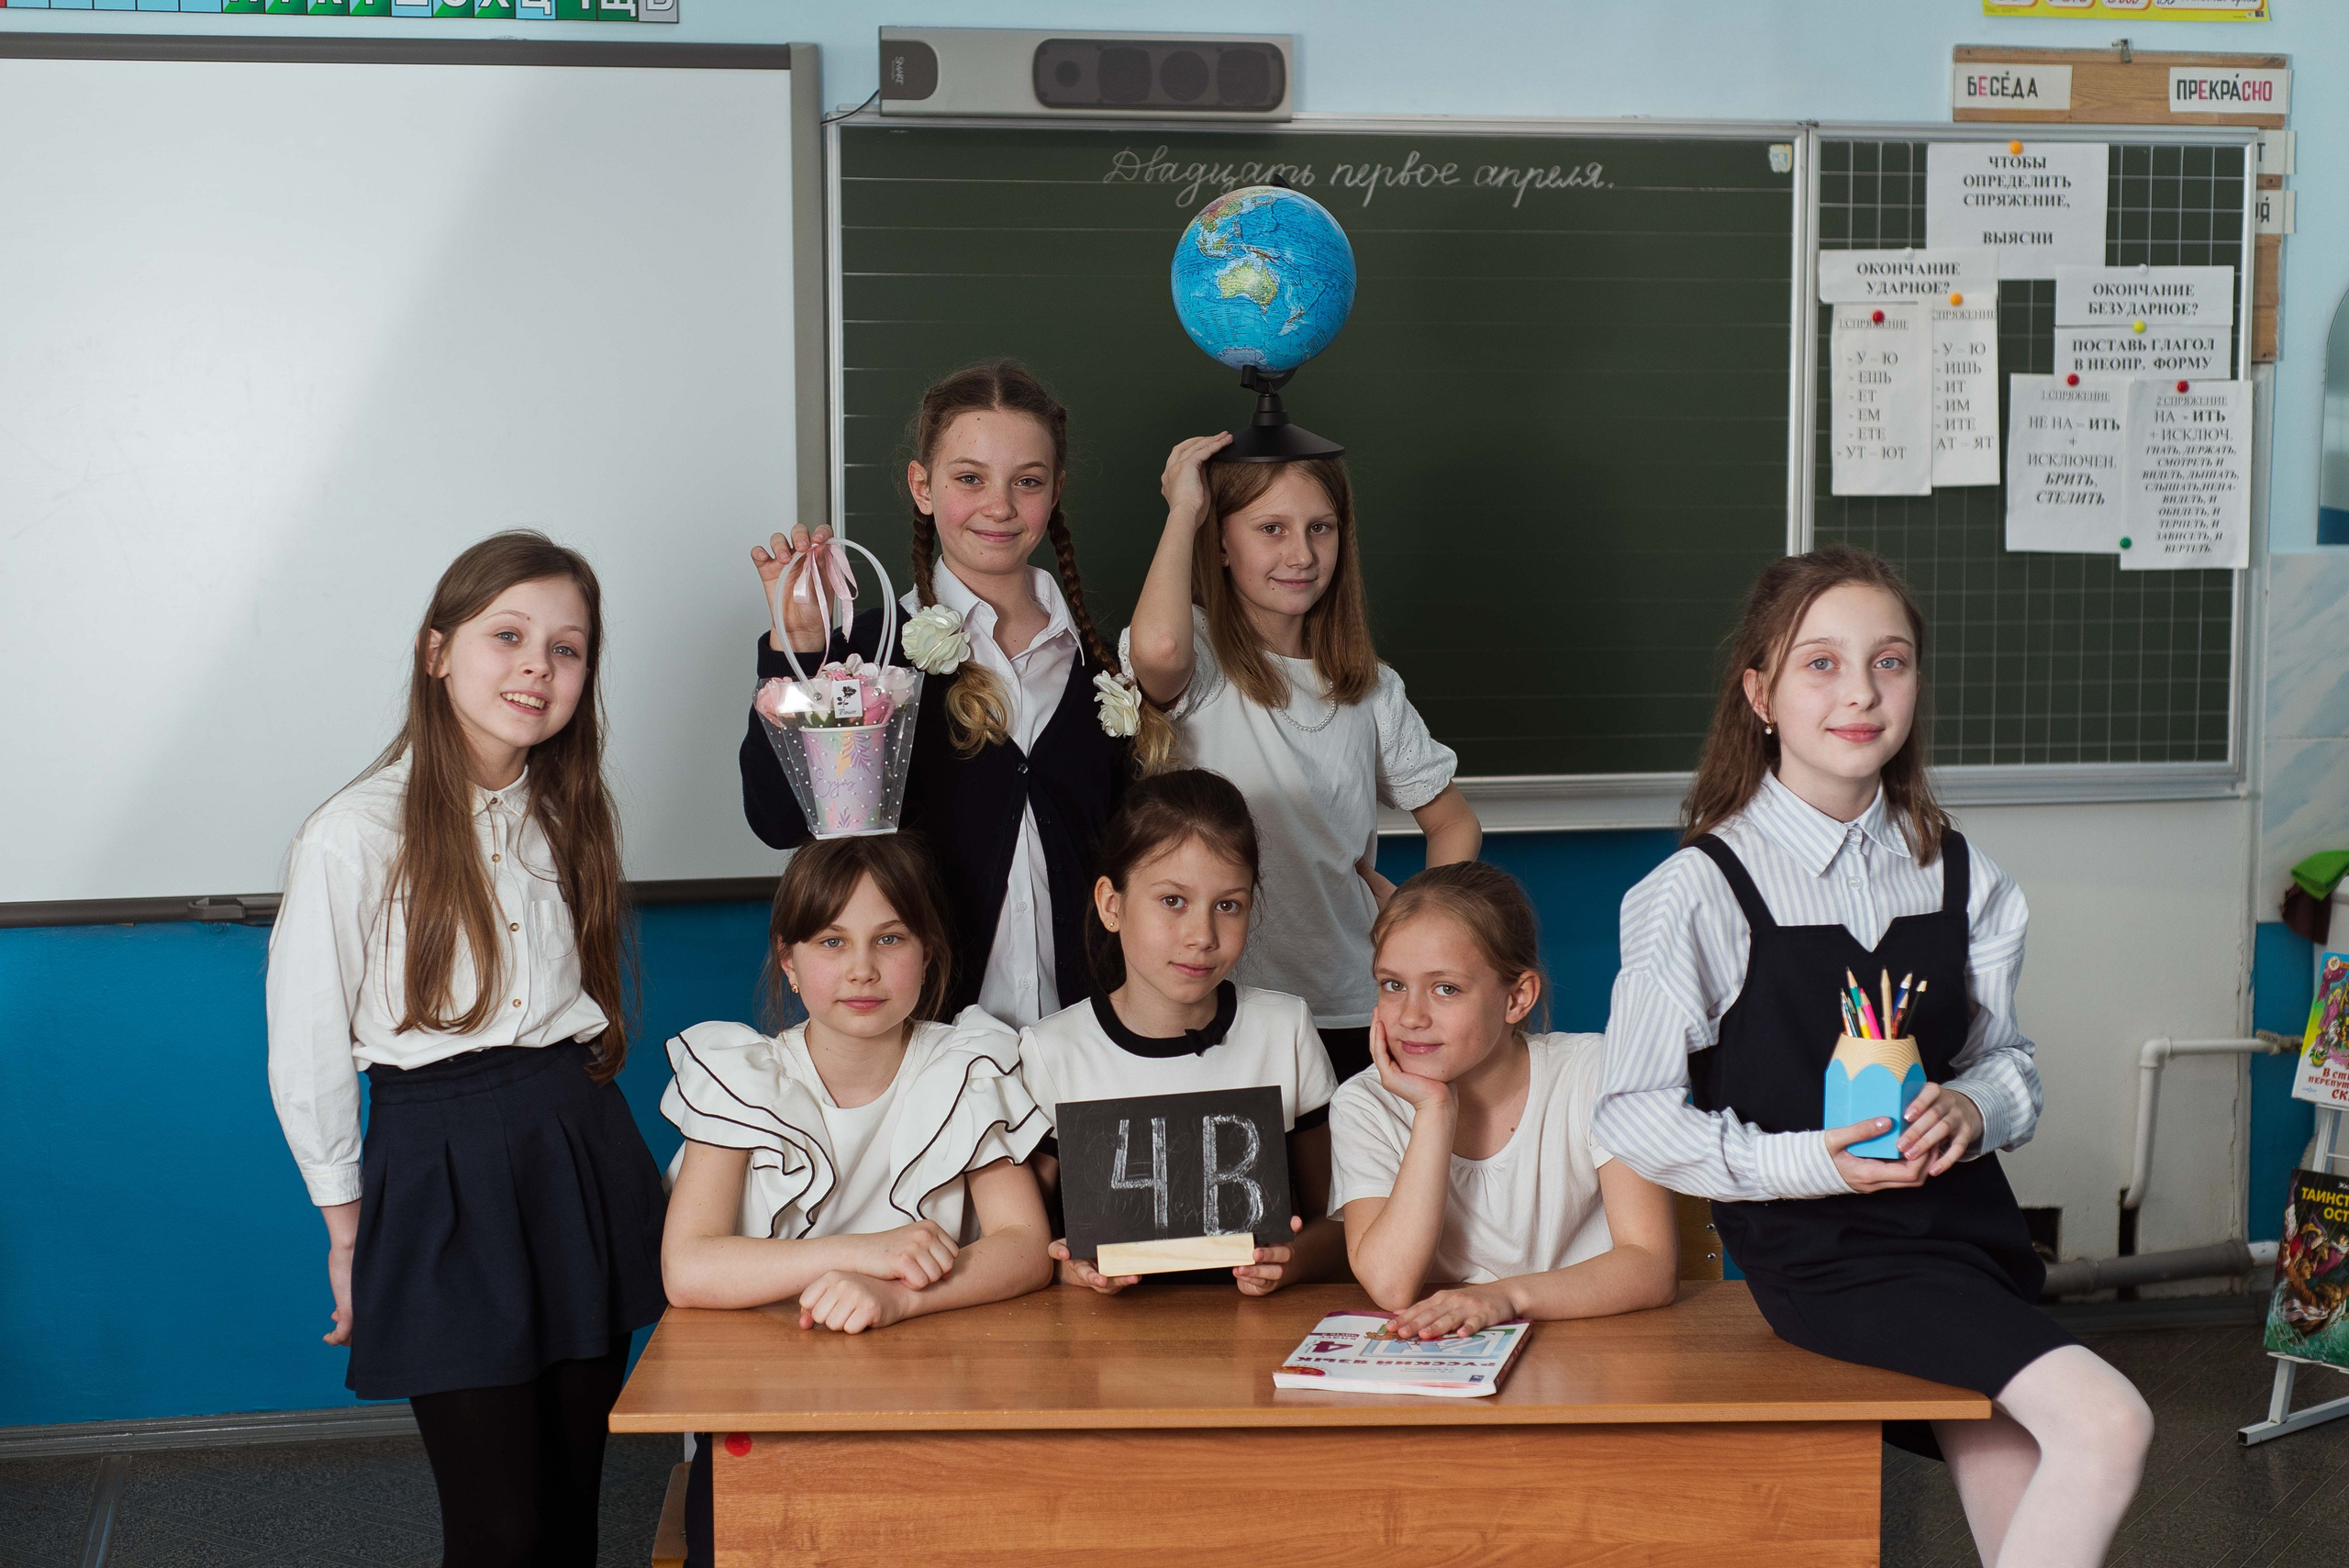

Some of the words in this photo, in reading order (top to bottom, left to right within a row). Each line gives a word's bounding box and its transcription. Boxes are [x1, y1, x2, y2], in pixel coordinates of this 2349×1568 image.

[1988, 155, 2047, 169] ЧТОБЫ
[1102, 145, 1316, 208] Двадцать
[1330, 150, 1461, 208] первое
[1472, 161, 1615, 209] апреля.
[1963, 174, 2072, 190] ОПРЕДЕЛИТЬ
[1963, 193, 2071, 209] СПРЯЖЕНИЕ,
[1982, 230, 2054, 245] ВЫЯСНИ
[1856, 261, 1961, 276] ОКОНЧАНИЕ
[1865, 280, 1951, 296] УДАРНОЕ?
[2092, 283, 2196, 297] ОКОНЧАНИЕ
[2087, 301, 2199, 317] БЕЗУДАРНОЕ?
[2072, 338, 2147, 352] ПОСТАВЬ
[2151, 338, 2215, 352] ГЛАГОЛ
[2074, 358, 2084, 371] В
[2153, 356, 2212, 371] ФОРМУ
[2164, 395, 2228, 406] СПРЯЖЕНИЕ
[2029, 416, 2048, 429] НЕ
[2052, 416, 2073, 430] НА
[2088, 417, 2121, 431] ИТЬ
[2035, 490, 2106, 506] СТЕЛИТЬ
[1311, 1340, 1354, 1354] 4
[1295, 1355, 1368, 1365] ЯЗЫК
[1375, 1359, 1497, 1368] РУССКИЙ
